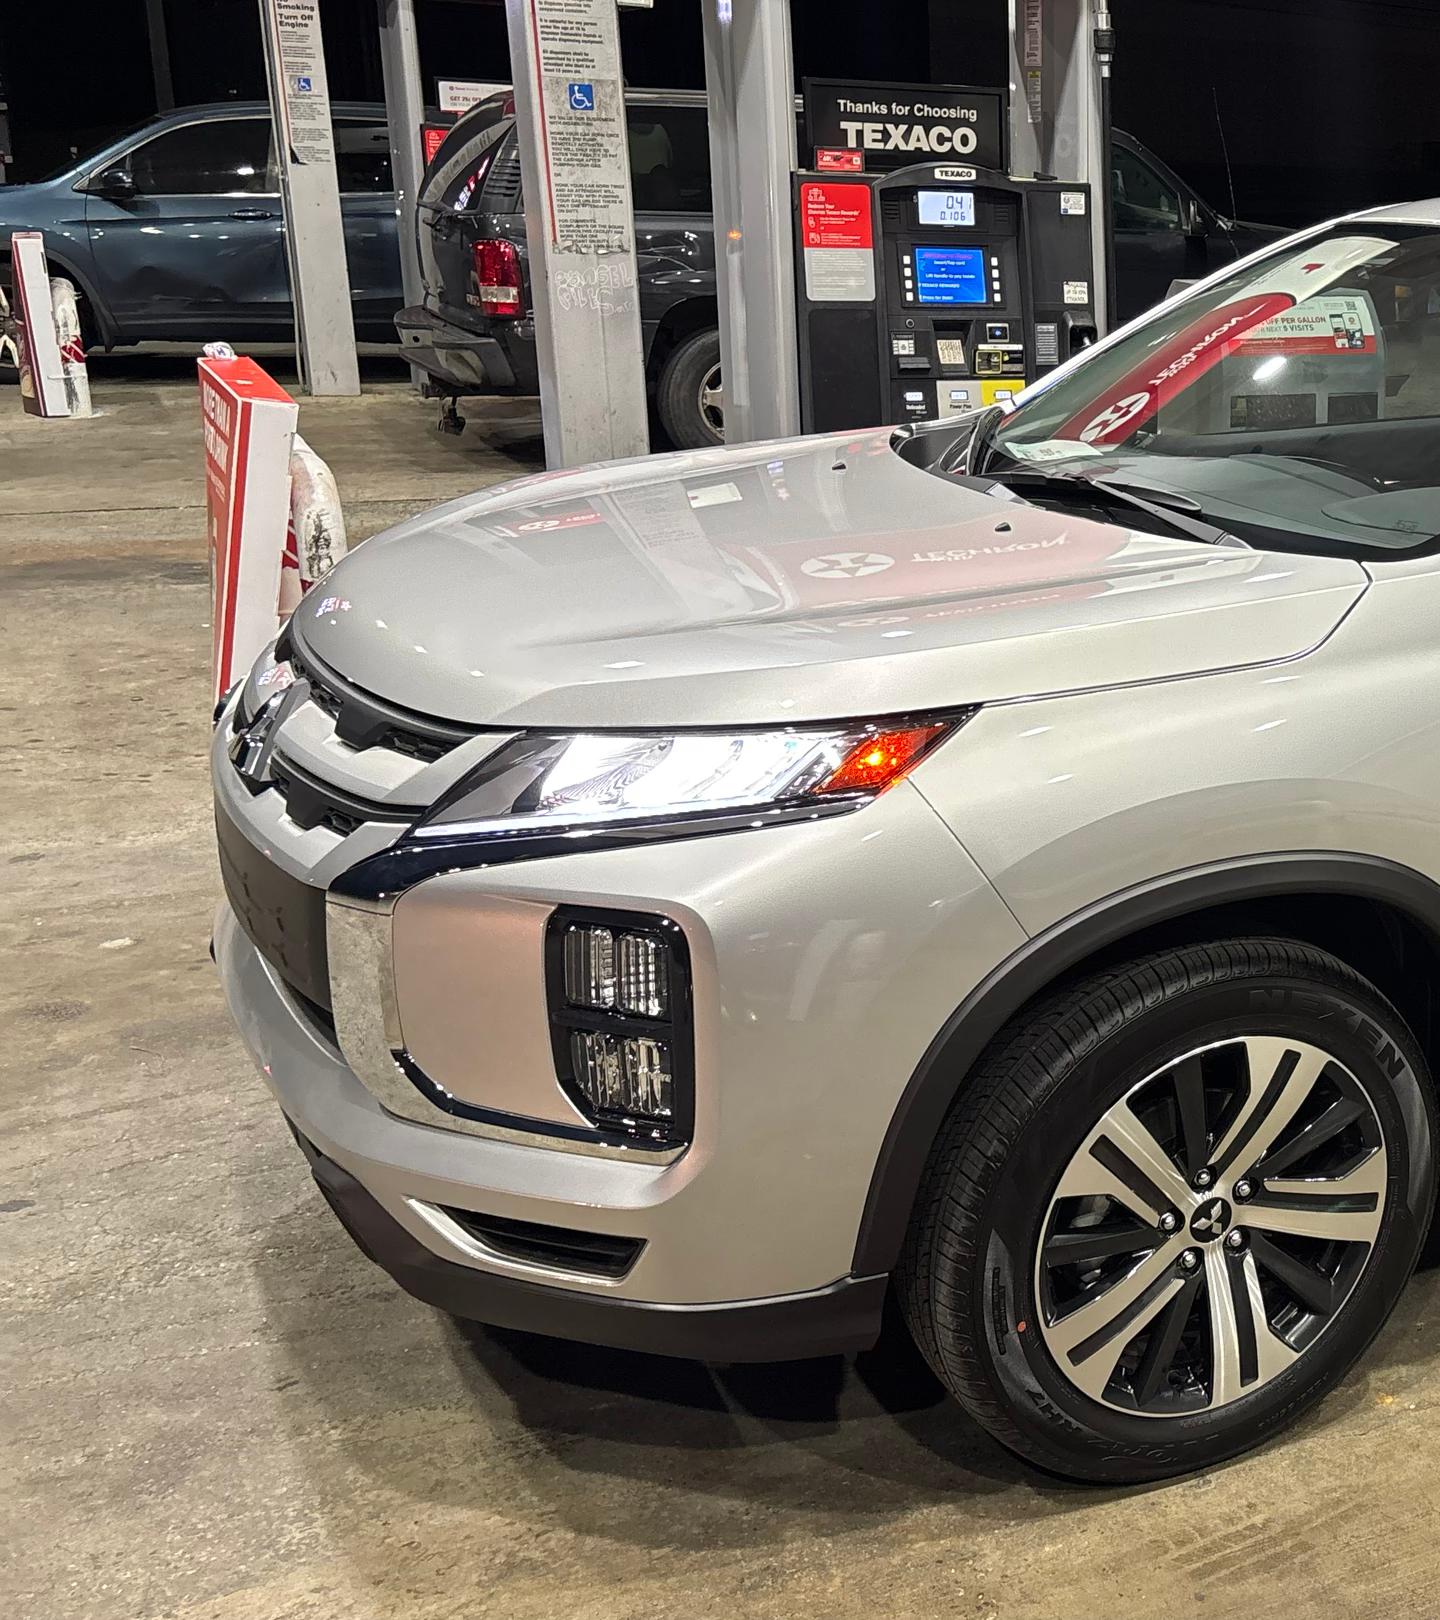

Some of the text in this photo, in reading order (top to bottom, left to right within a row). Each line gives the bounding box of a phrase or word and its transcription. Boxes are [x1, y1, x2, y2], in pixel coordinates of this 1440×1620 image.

[277, 3, 314, 11] Smoking
[837, 99, 977, 122] Thanks for Choosing
[840, 121, 977, 154] TEXACO
